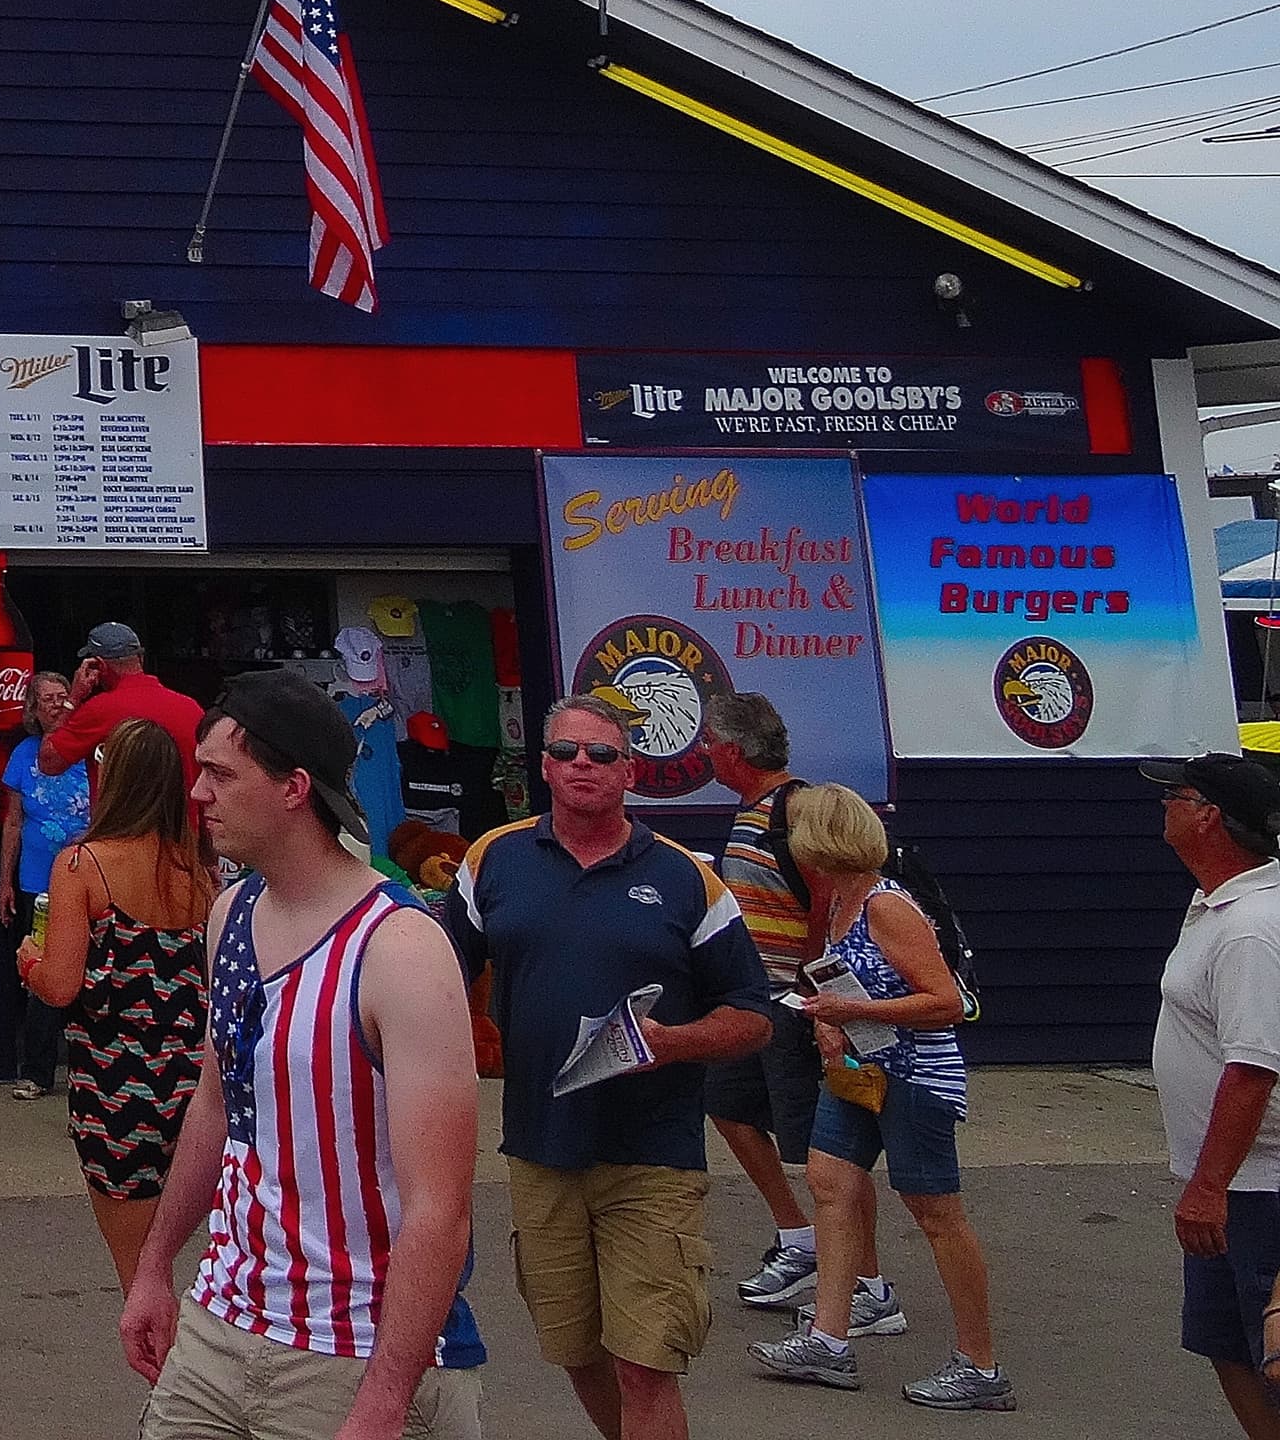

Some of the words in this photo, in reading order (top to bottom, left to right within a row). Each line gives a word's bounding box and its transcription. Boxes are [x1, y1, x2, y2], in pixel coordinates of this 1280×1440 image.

[0, 353, 74, 390] Miller
[71, 345, 171, 406] Lite
[767, 367, 861, 384] WELCOME
[865, 367, 892, 383] TO
[629, 384, 683, 419] Lite
[705, 386, 807, 412] MAJOR
[810, 386, 962, 411] GOOLSBY'S
[715, 416, 771, 434] WE'RE
[773, 416, 822, 436] FAST,
[824, 415, 878, 434] FRESH
[882, 414, 896, 432] &
[898, 413, 958, 432] CHEAP
[563, 468, 740, 551] Serving
[955, 492, 1092, 525] World
[667, 526, 854, 570] Breakfast
[929, 537, 1117, 571] Famous
[693, 573, 810, 612] Lunch
[821, 576, 855, 611] &
[940, 583, 1131, 622] Burgers
[594, 627, 704, 676] MAJOR
[733, 620, 865, 660] Dinner
[1008, 643, 1072, 674] MAJOR
